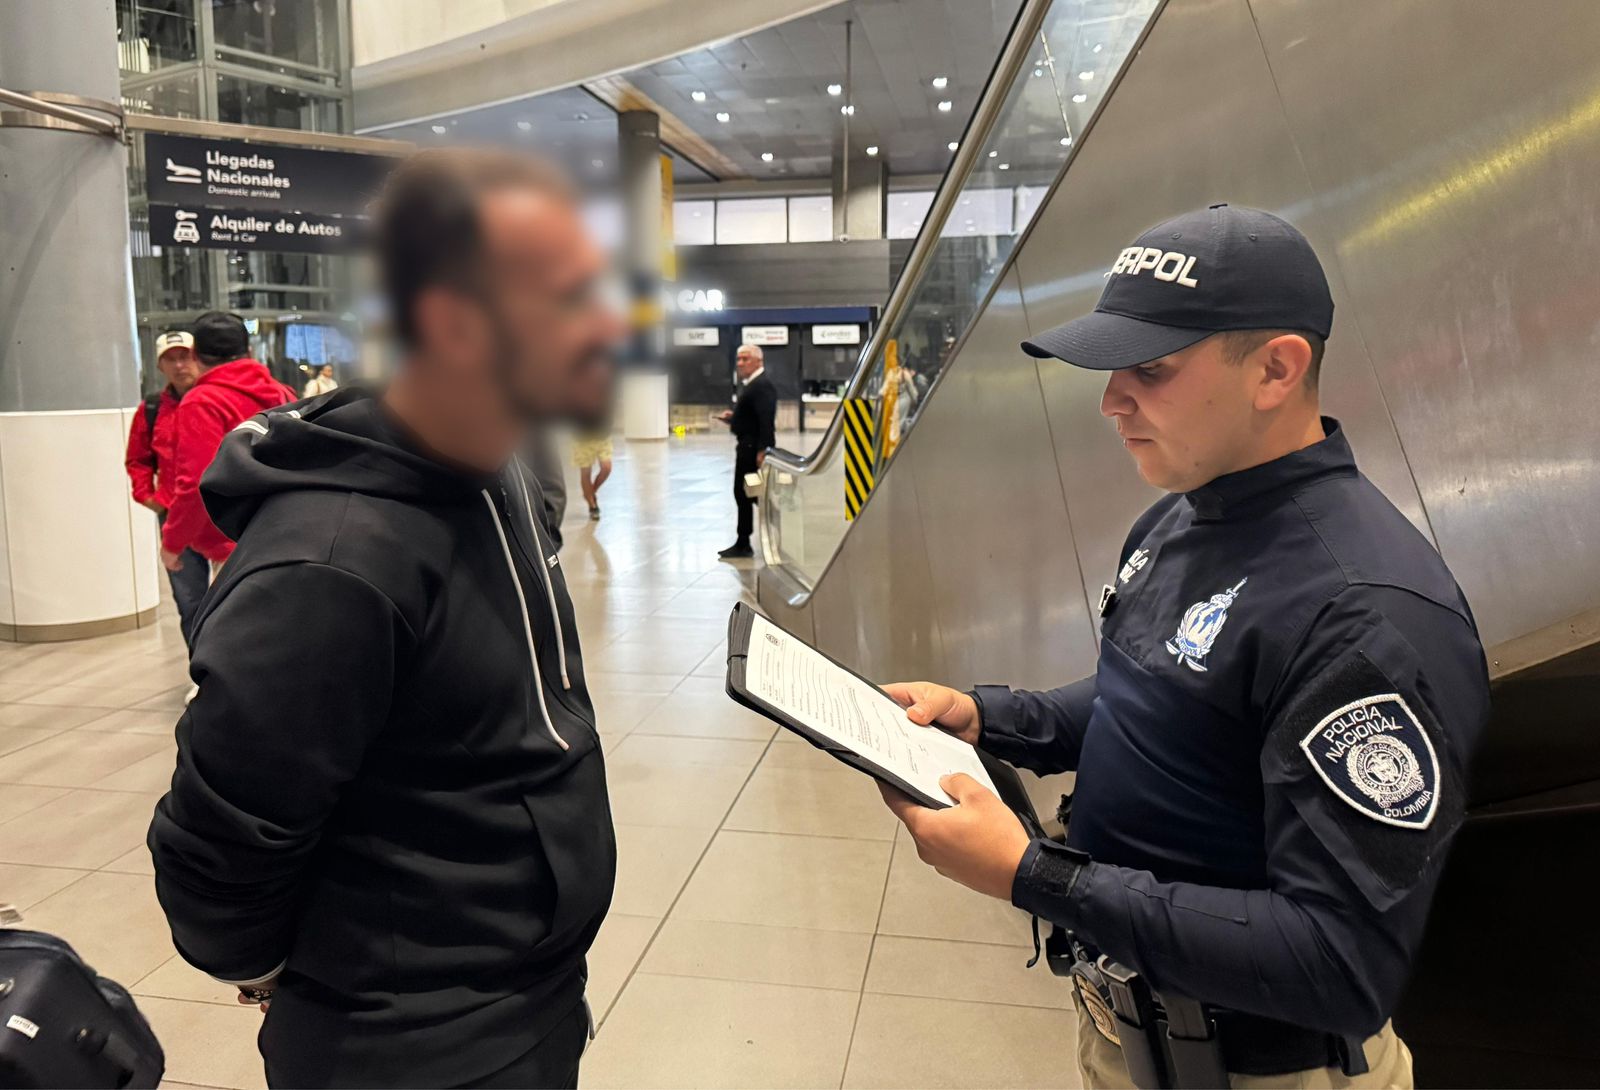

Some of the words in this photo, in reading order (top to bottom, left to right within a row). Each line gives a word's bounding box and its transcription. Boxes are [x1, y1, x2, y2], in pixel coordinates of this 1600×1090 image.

[206, 150, 275, 170] Llegadas
[207, 168, 291, 188] Nacionales
[210, 215, 272, 233] Alquiler
[274, 219, 295, 234] de
[298, 221, 342, 236] Autos
[1104, 246, 1198, 288] ERPOL
[677, 289, 723, 312] CAR
[1325, 716, 1403, 764] NACIONAL
[1384, 789, 1433, 818] COLOMBIA
